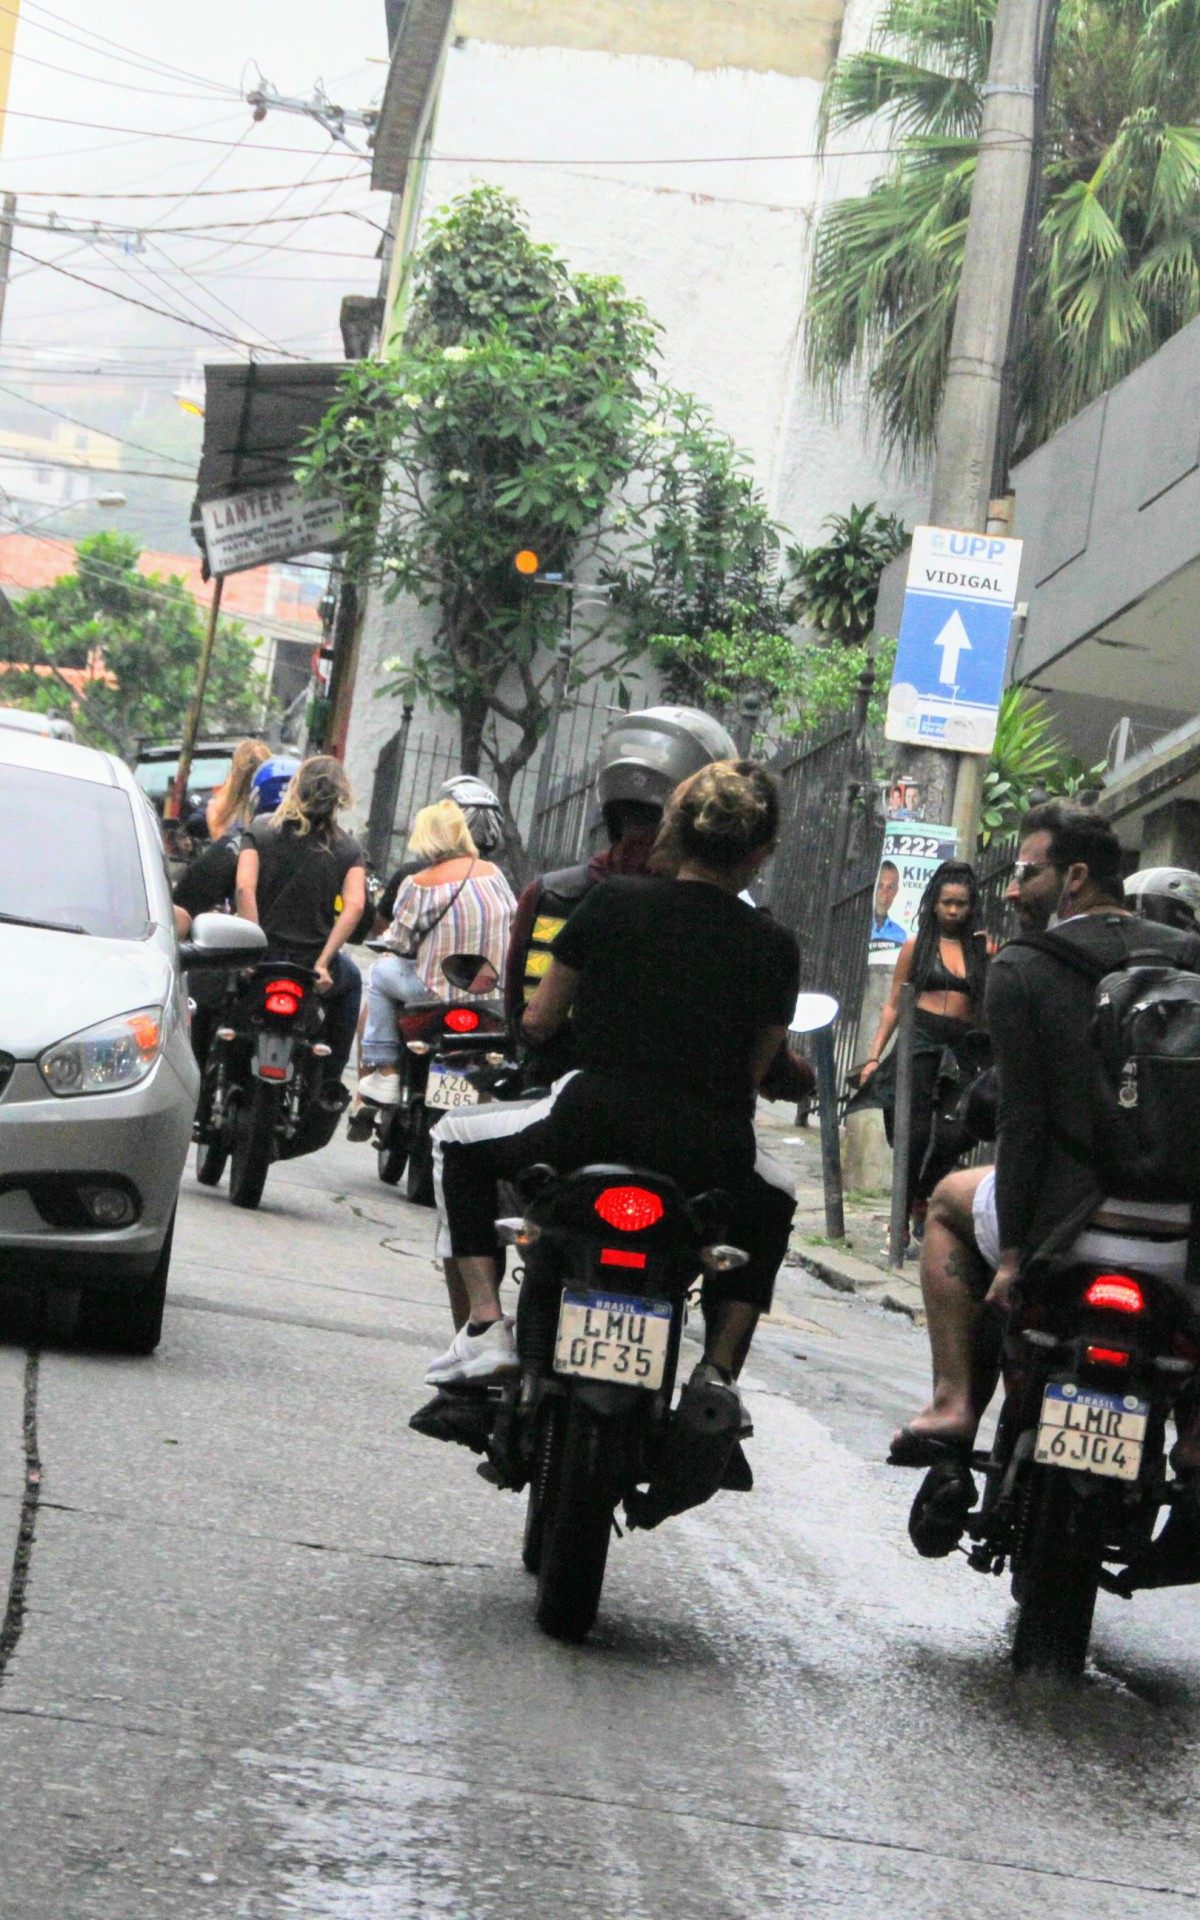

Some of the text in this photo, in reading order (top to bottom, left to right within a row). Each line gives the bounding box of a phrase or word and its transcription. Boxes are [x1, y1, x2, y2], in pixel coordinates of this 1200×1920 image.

[949, 534, 1006, 559] UPP
[925, 569, 1002, 592] VIDIGAL
[882, 836, 939, 858] 3.222
[903, 866, 934, 881] KIK
[596, 1300, 636, 1313] BRASIL
[584, 1309, 646, 1344] LMU
[1076, 1395, 1115, 1409] BRASIL
[1065, 1404, 1122, 1437] LMR
